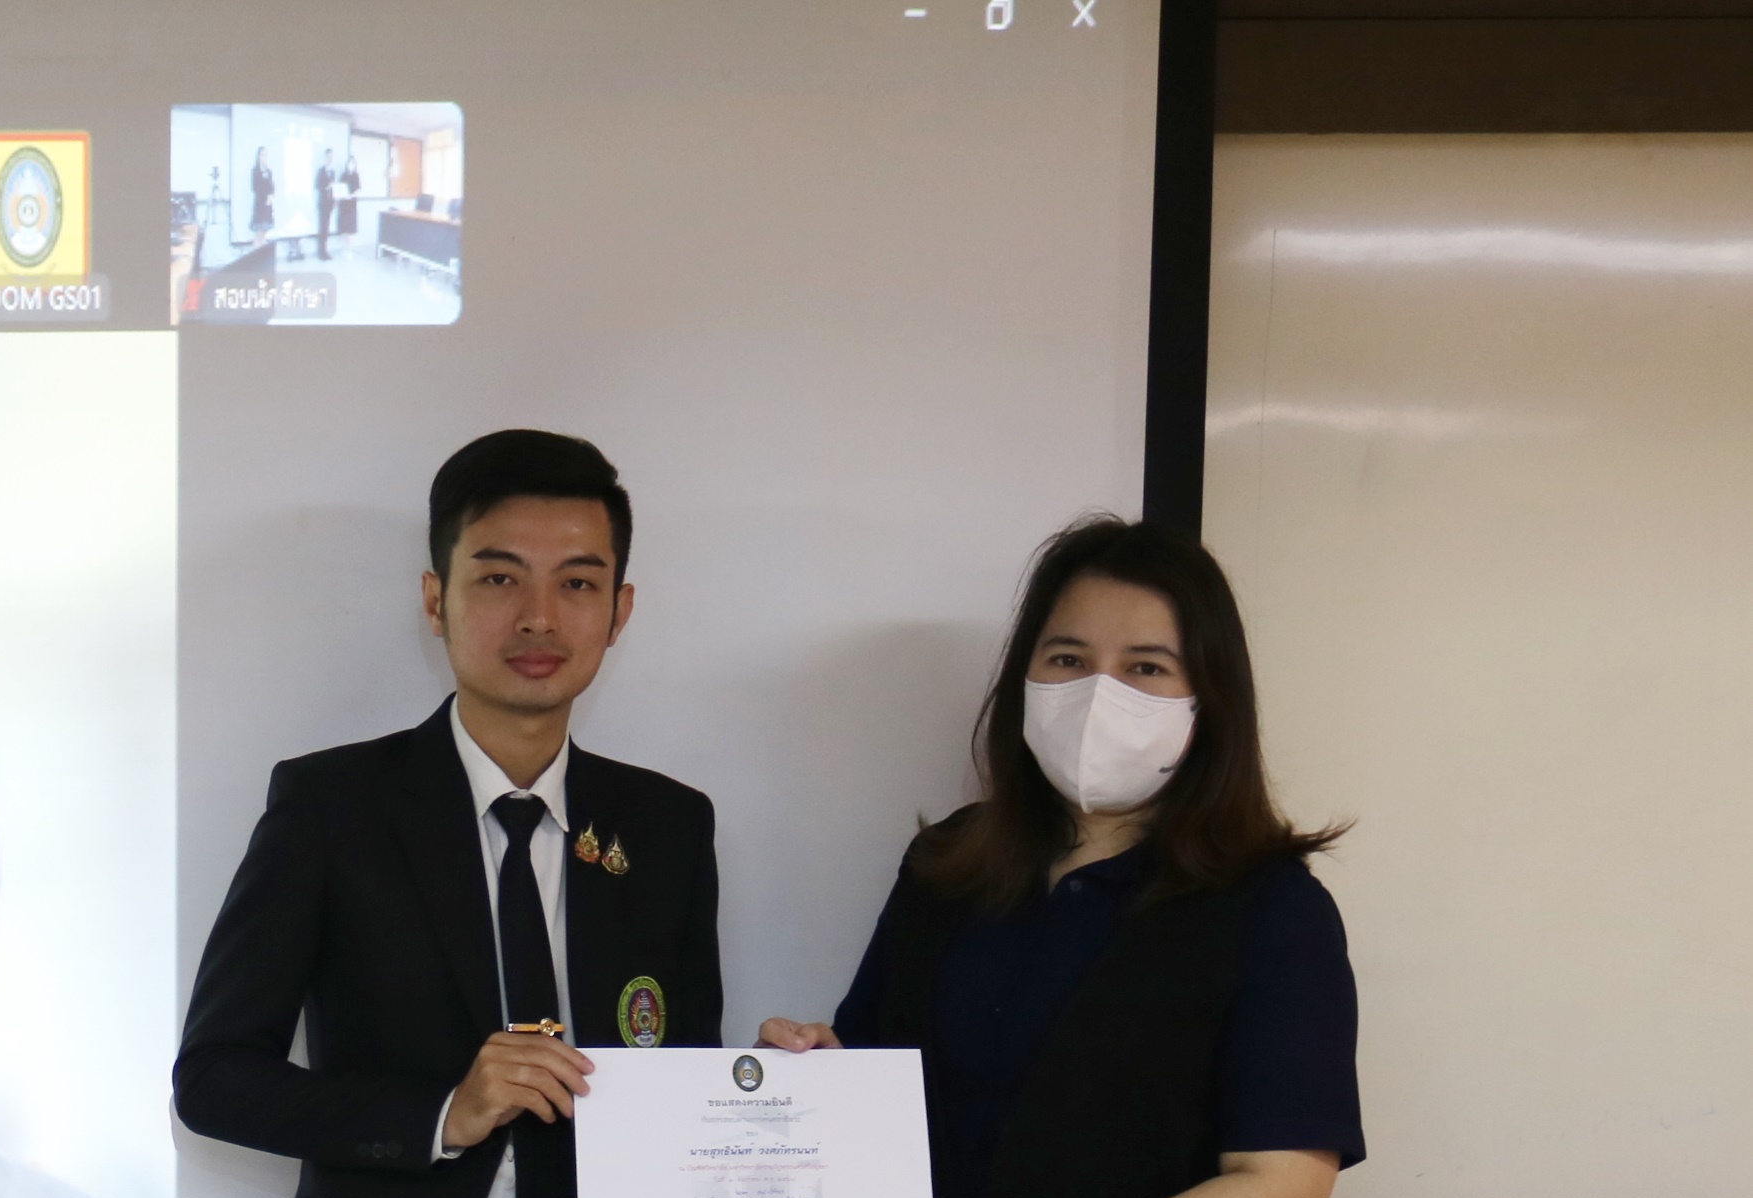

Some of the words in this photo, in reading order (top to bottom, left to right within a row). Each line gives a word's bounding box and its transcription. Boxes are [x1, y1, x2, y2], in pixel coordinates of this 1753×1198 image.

[49, 285, 102, 310] GS01
[707, 1096, 793, 1108] ขอแสดงความยินดี
